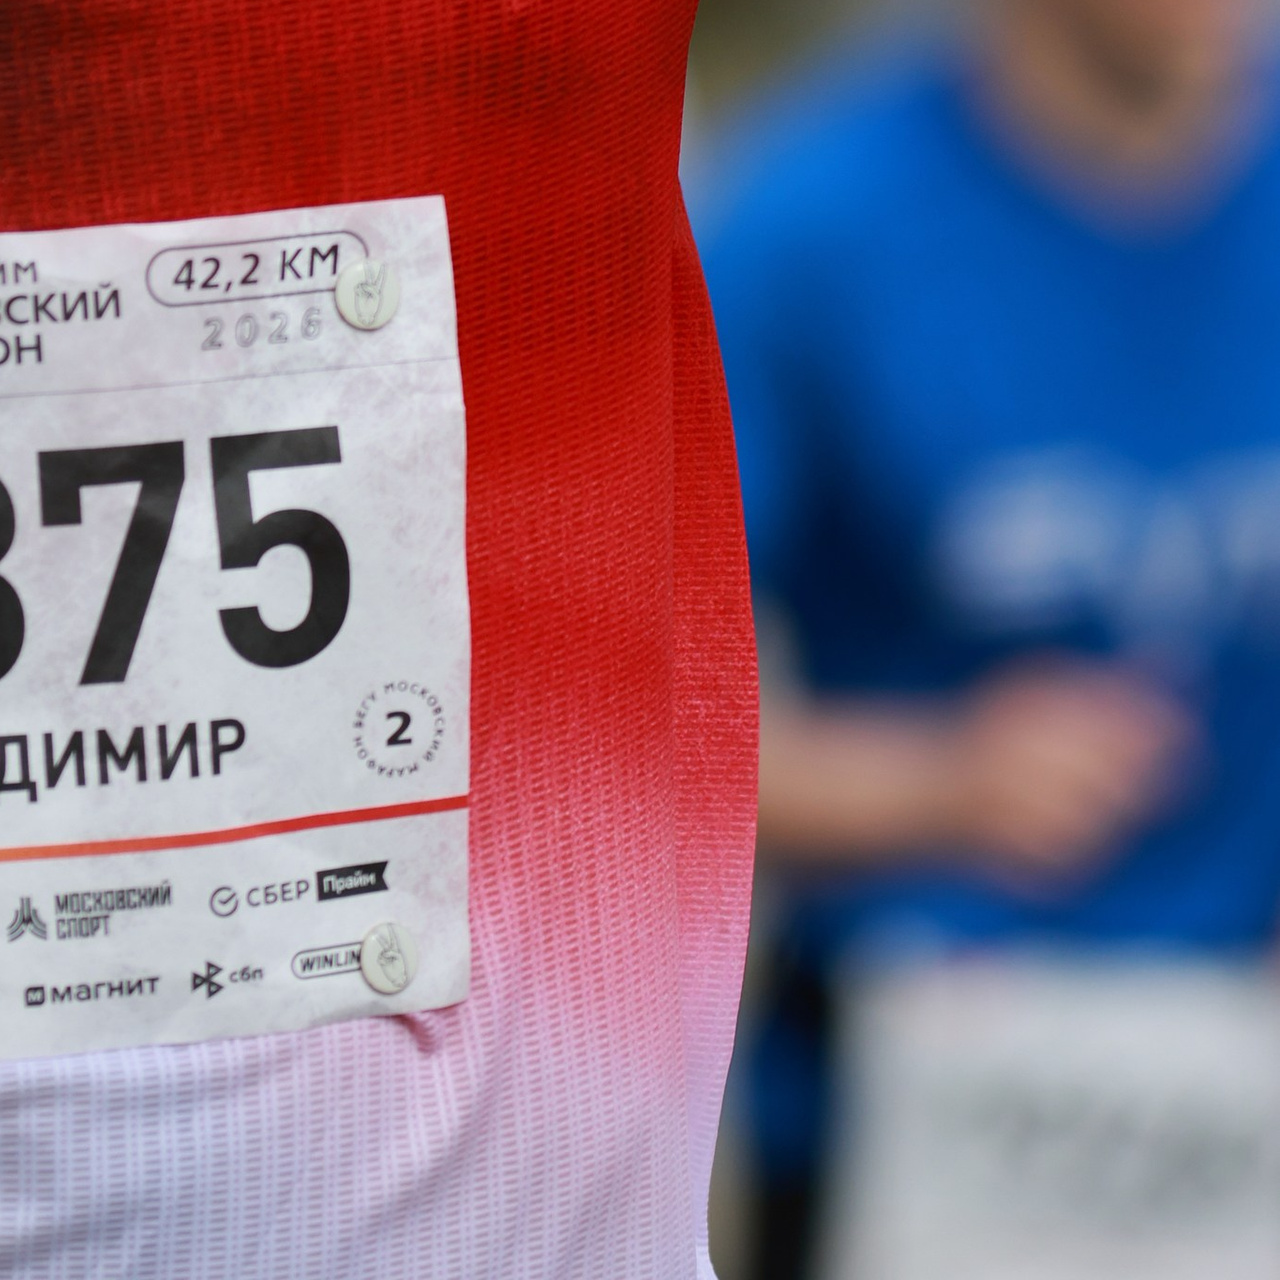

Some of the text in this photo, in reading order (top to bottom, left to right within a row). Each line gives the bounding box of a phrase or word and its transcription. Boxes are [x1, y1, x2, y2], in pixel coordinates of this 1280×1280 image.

[173, 243, 339, 292] 42,2 КМ
[385, 710, 413, 747] 2
[54, 879, 173, 915] МОСКОВСКИЙ
[246, 870, 377, 908] СБЕР Прайм
[55, 914, 111, 941] СПОРТ
[228, 966, 265, 984] сбп
[299, 949, 362, 973] WINLIN
[50, 977, 160, 1003] магнит
